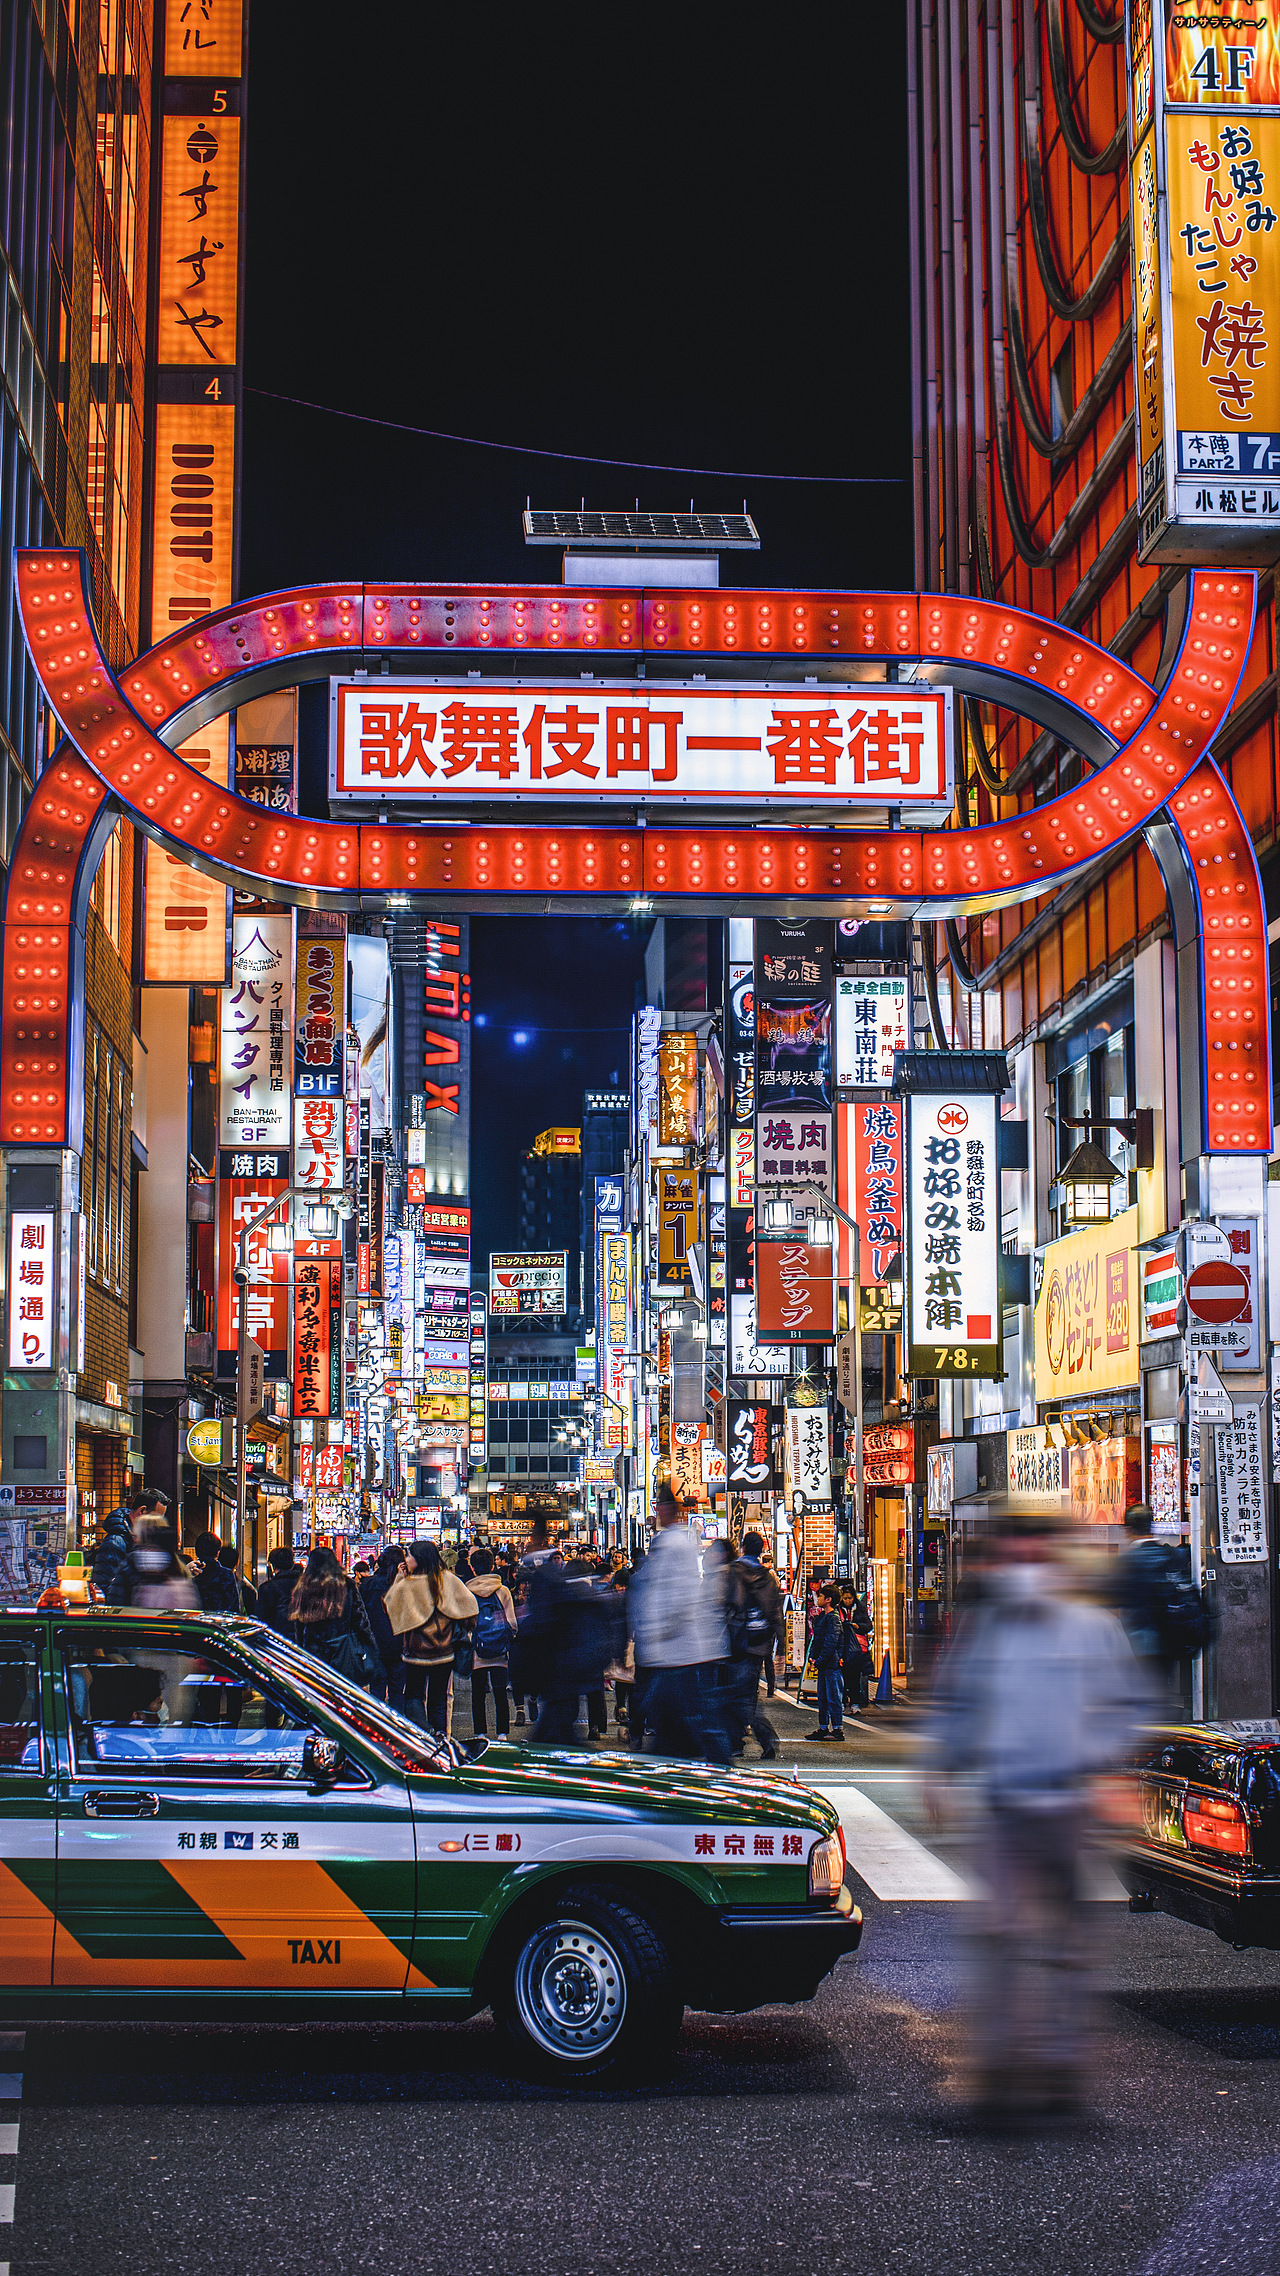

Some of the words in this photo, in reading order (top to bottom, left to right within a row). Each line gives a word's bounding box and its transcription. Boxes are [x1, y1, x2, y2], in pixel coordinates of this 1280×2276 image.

[1174, 16, 1267, 29] サルサラティーノ
[1190, 47, 1256, 91] 4F
[212, 90, 228, 113] 5
[1219, 126, 1278, 233] お好み
[1188, 140, 1257, 282] もんじゃ
[174, 169, 225, 360] すずや
[1196, 299, 1268, 422] 焼き
[205, 377, 223, 399] 4
[1188, 435, 1230, 455] 本陣
[1247, 436, 1280, 470] 7F
[1189, 455, 1235, 470] PART2
[1195, 488, 1280, 514] 小松ビル
[360, 702, 923, 785] 歌舞伎町一番街
[233, 960, 281, 972] RESTAURANT
[238, 957, 275, 966] BAN-THAI
[732, 970, 746, 979] 4F
[840, 981, 904, 996] 全卓全自動
[304, 946, 334, 1066] まぐろ商店
[761, 1002, 771, 1010] 2F
[229, 979, 265, 1100] バンタイ
[269, 981, 284, 1092] タイ国料理専門店
[854, 998, 878, 1084] 東南荘
[881, 1025, 893, 1077] 専門店
[299, 1073, 340, 1091] B1F
[759, 1070, 826, 1086] 酒場牧場
[839, 1073, 852, 1084] 3F
[227, 1116, 283, 1125] RESTAURANT
[233, 1108, 277, 1116] BAN-THAI
[241, 1127, 268, 1142] 3F
[762, 1119, 827, 1151] 焼肉
[231, 1154, 279, 1177] 焼肉
[735, 1131, 756, 1204] クアトロ
[762, 1159, 828, 1176] 韓国料理
[663, 1184, 694, 1198] 麻雀
[863, 1105, 898, 1282] 焼鳥釜めし
[966, 1139, 986, 1232] 歌舞伎町名物
[664, 1202, 694, 1211] ナンバー
[663, 1212, 687, 1260] 1
[923, 1135, 964, 1331] お好み焼本陣
[305, 1241, 331, 1256] 4F
[492, 1256, 564, 1266] コミック&ネットカフェ
[666, 1266, 691, 1280] 4F
[19, 1224, 46, 1356] 劇場通り
[609, 1240, 627, 1344] まんが喫茶
[778, 1245, 814, 1328] ステップ
[1065, 1252, 1100, 1320] やきとり
[864, 1312, 902, 1330] 2F
[790, 1330, 803, 1338] B1
[1190, 1331, 1247, 1347] 自転車を除く
[734, 1345, 744, 1374] 一番街
[769, 1363, 789, 1373] B1F
[421, 1402, 451, 1416] ゲーム
[422, 1426, 466, 1438] メンズサウナ
[676, 1427, 699, 1440] 新宿
[790, 1415, 798, 1447] HIROSHIMA
[1225, 1433, 1233, 1451] Your
[802, 1415, 828, 1491] お好み焼き
[1217, 1431, 1226, 1463] Security
[1226, 1453, 1235, 1478] Safety
[1233, 1417, 1252, 1537] 防犯カメラ作動中
[1246, 1410, 1263, 1542] みなさまの安全を守ります
[1219, 1464, 1227, 1495] Camera
[811, 1503, 832, 1513] B1F
[1221, 1506, 1231, 1545] Operation
[1235, 1553, 1257, 1561] Police
[177, 1831, 218, 1849] 和親
[260, 1831, 301, 1850] 交通
[463, 1833, 523, 1853] (三鷹)
[694, 1833, 804, 1857] 東京無線
[287, 1939, 341, 1965] TAXI
